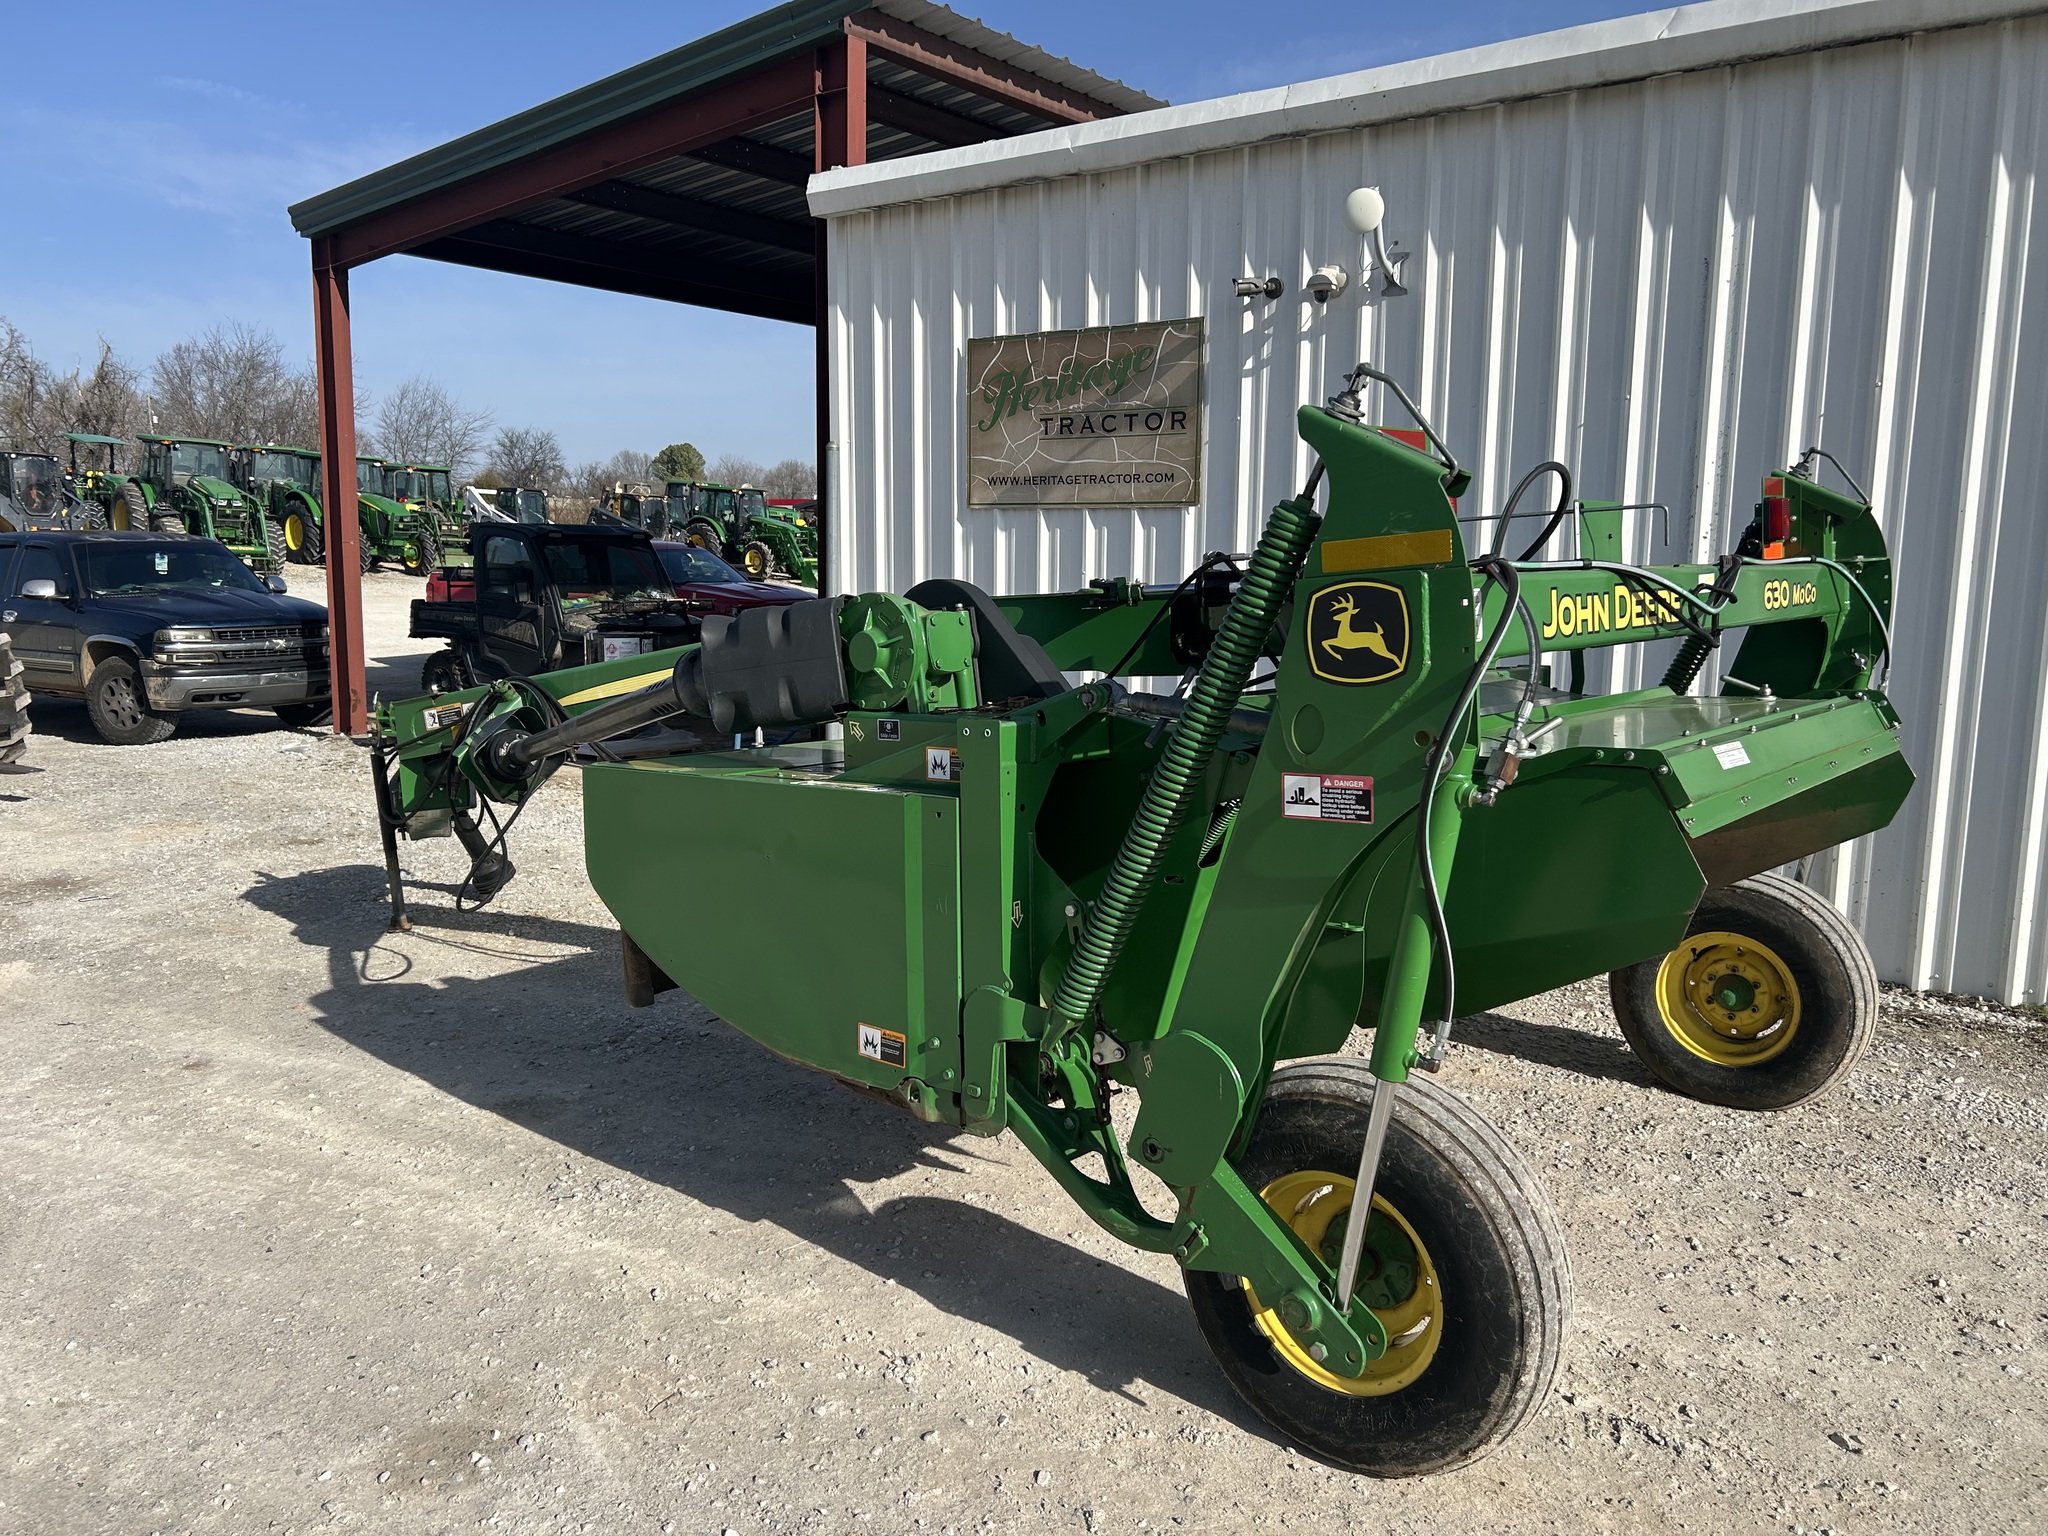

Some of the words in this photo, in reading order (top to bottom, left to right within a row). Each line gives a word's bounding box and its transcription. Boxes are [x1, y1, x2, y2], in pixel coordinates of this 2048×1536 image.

[978, 346, 1158, 432] Heritage
[1040, 411, 1187, 435] TRACTOR
[987, 473, 1175, 487] WWW.HERITAGETRACTOR.COM
[1764, 579, 1790, 611] 630
[1543, 587, 1610, 639] JOHN
[1334, 780, 1364, 788] DANGER
